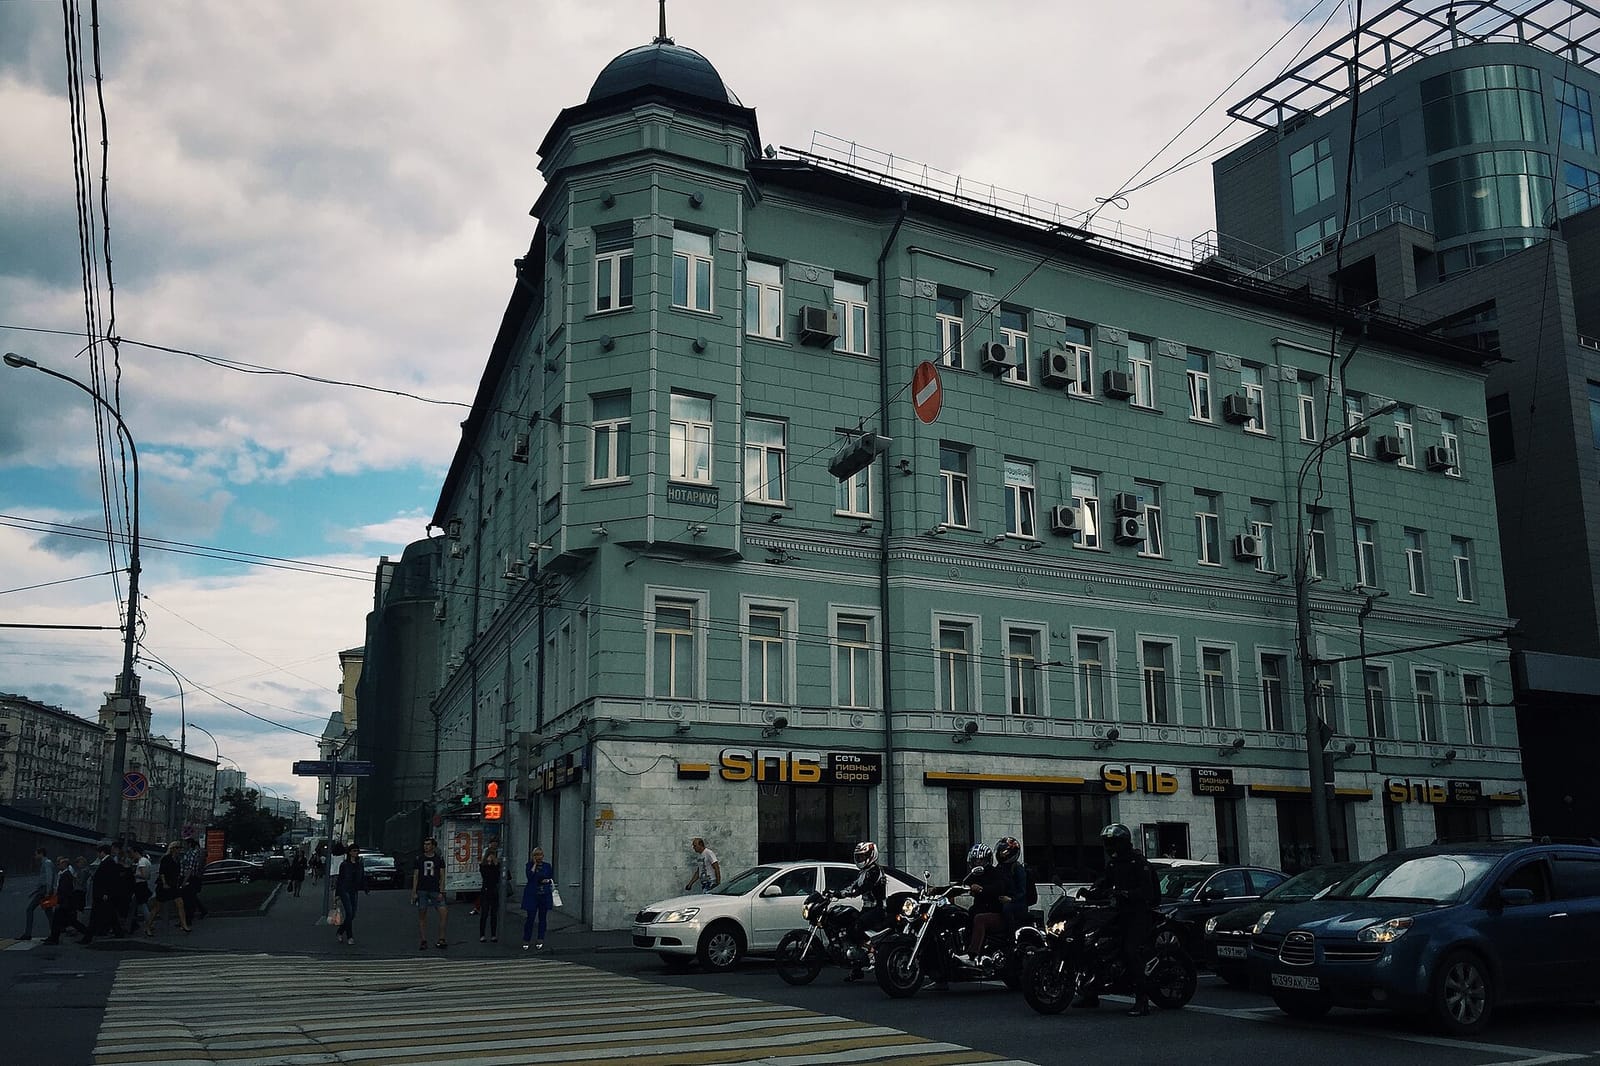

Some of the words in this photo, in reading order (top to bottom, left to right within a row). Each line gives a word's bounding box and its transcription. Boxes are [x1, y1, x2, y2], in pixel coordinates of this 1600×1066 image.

[668, 488, 718, 505] НОТАРИУС
[835, 754, 861, 763] сеть
[835, 763, 878, 773] пивных
[835, 771, 870, 781] баров
[423, 860, 435, 877] R
